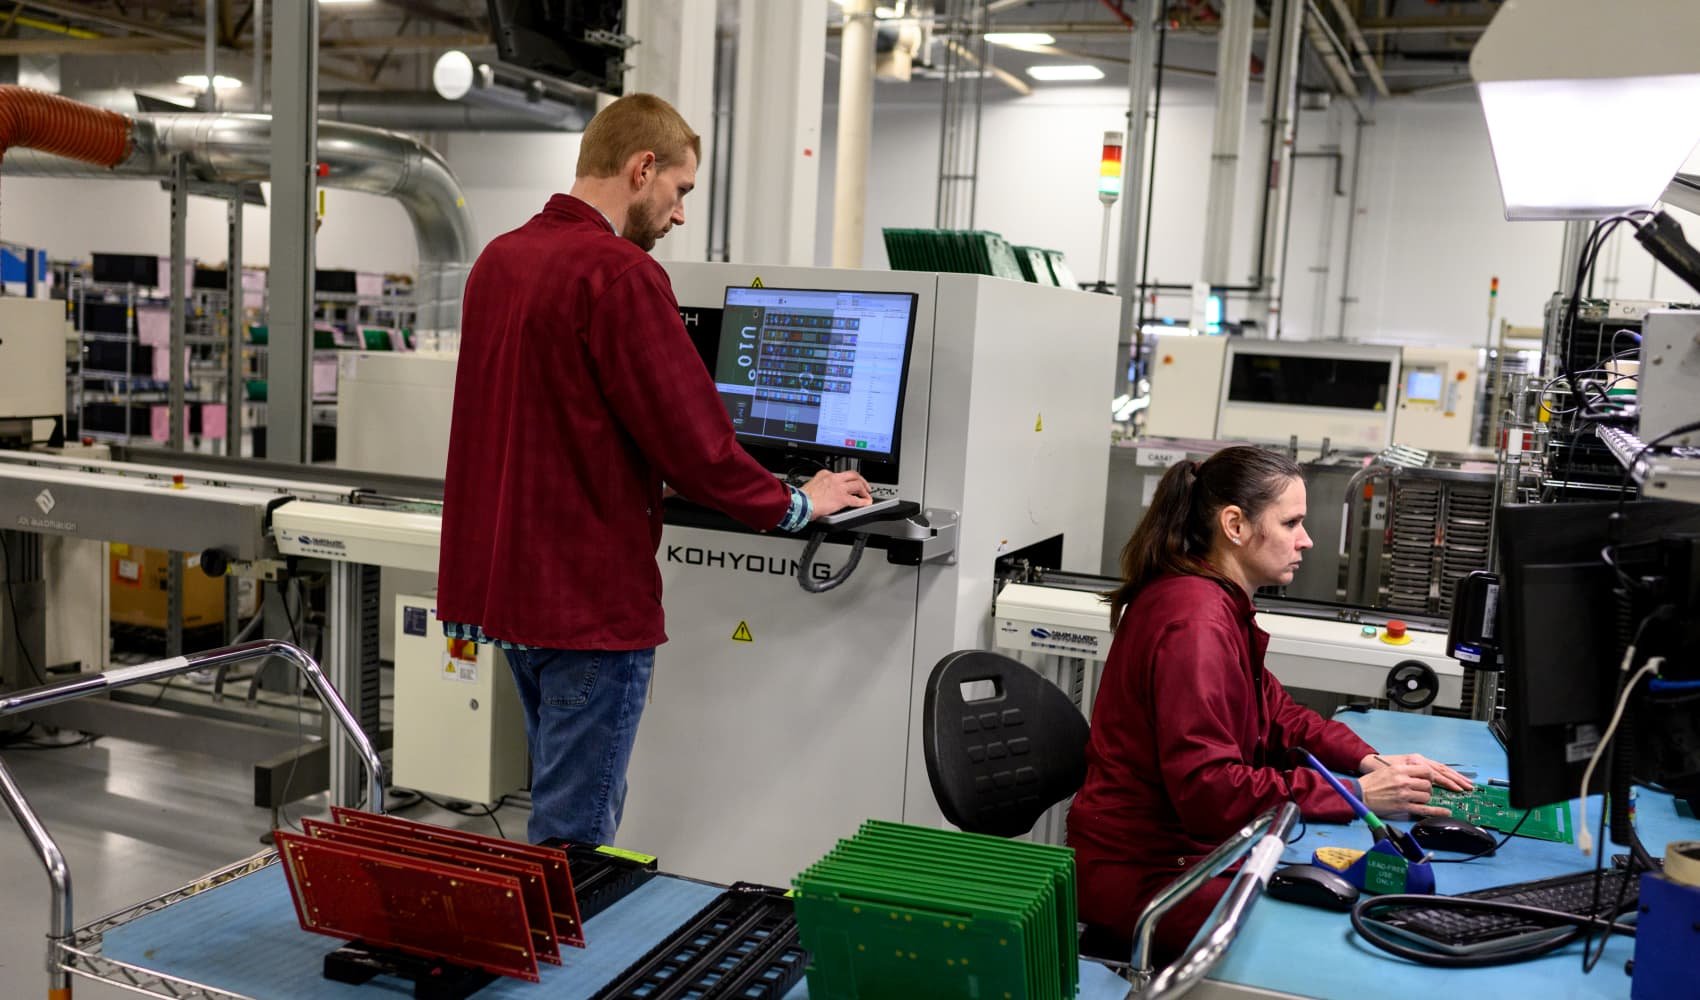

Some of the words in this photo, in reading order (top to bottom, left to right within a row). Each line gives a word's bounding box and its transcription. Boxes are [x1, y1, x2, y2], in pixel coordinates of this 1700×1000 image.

[667, 545, 831, 580] KOHYOUNG
[1367, 859, 1406, 874] LEAD-FREE
[1378, 870, 1393, 878] USE
[1375, 877, 1394, 886] ONLY
